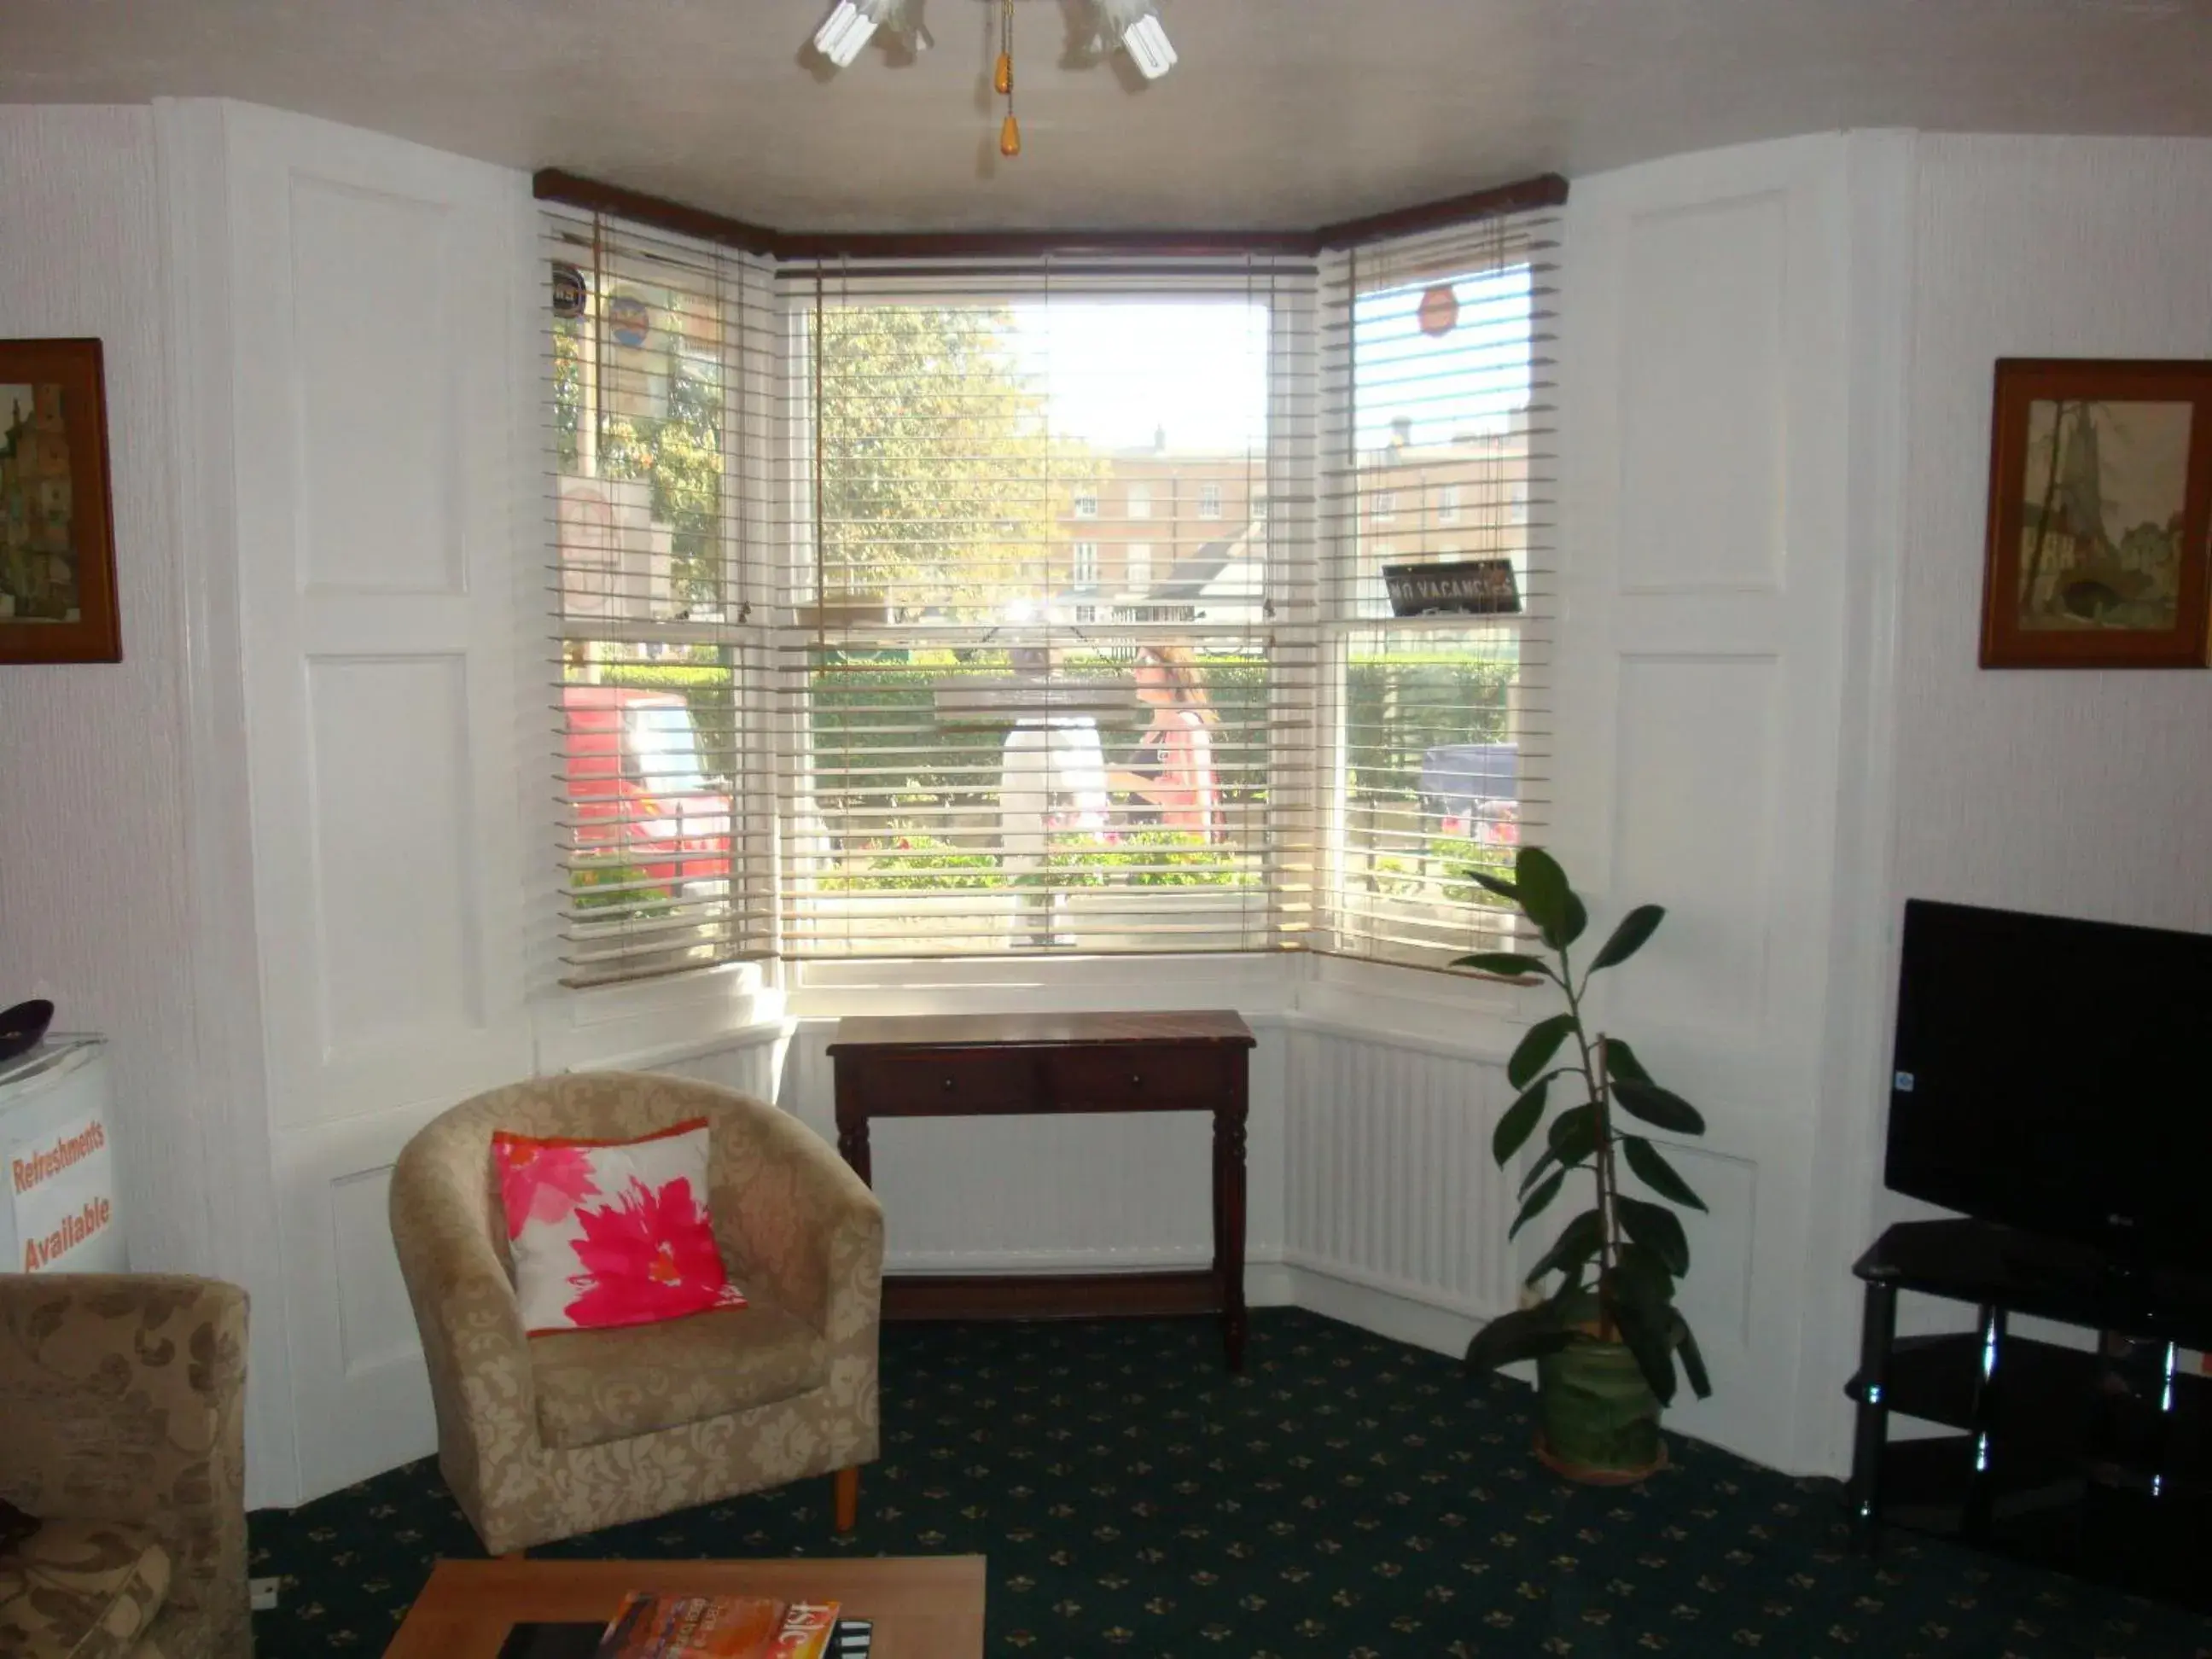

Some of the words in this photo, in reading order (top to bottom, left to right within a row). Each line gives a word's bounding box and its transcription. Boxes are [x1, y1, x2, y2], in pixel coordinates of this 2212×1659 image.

[1388, 580, 1413, 602] NO
[11, 1120, 105, 1195] Refreshments
[24, 1196, 110, 1274] Available
